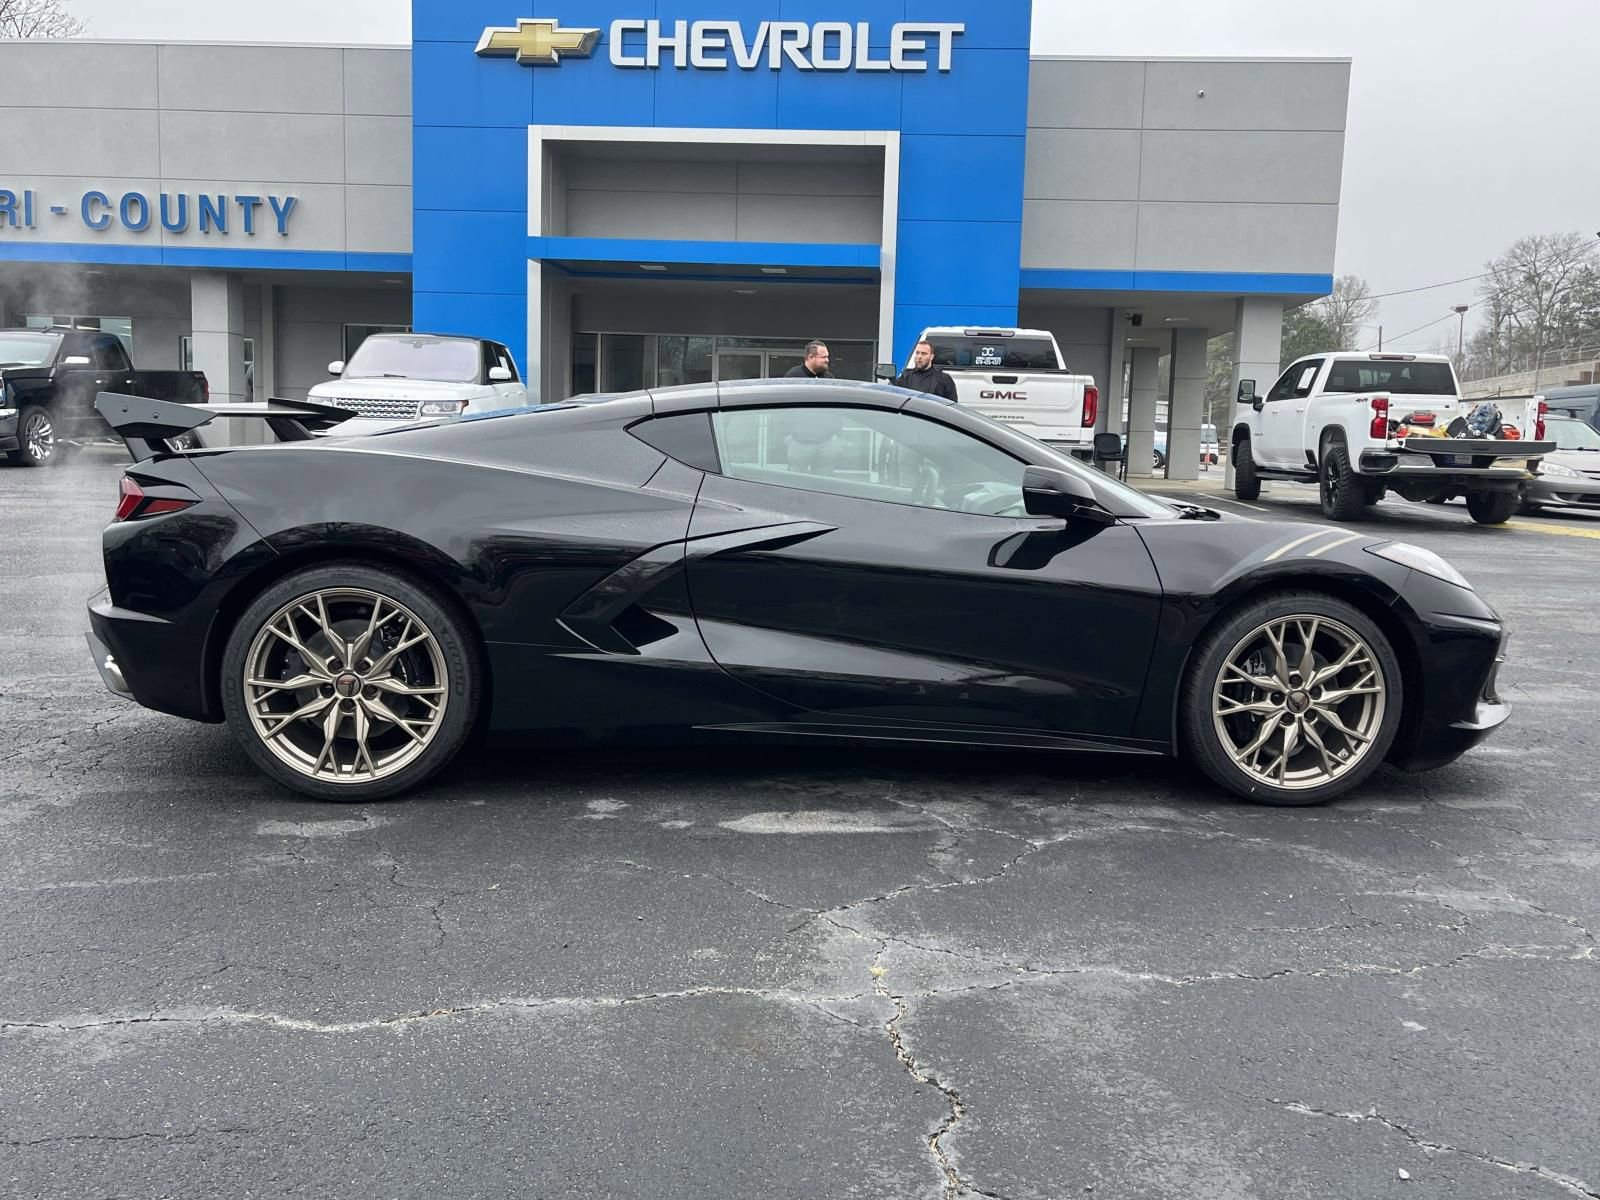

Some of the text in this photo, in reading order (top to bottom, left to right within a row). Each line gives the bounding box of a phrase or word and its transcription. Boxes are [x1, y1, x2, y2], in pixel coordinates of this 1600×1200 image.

[609, 19, 965, 71] CHEVROLET
[81, 190, 298, 236] COUNTY
[980, 390, 1027, 400] GMC
